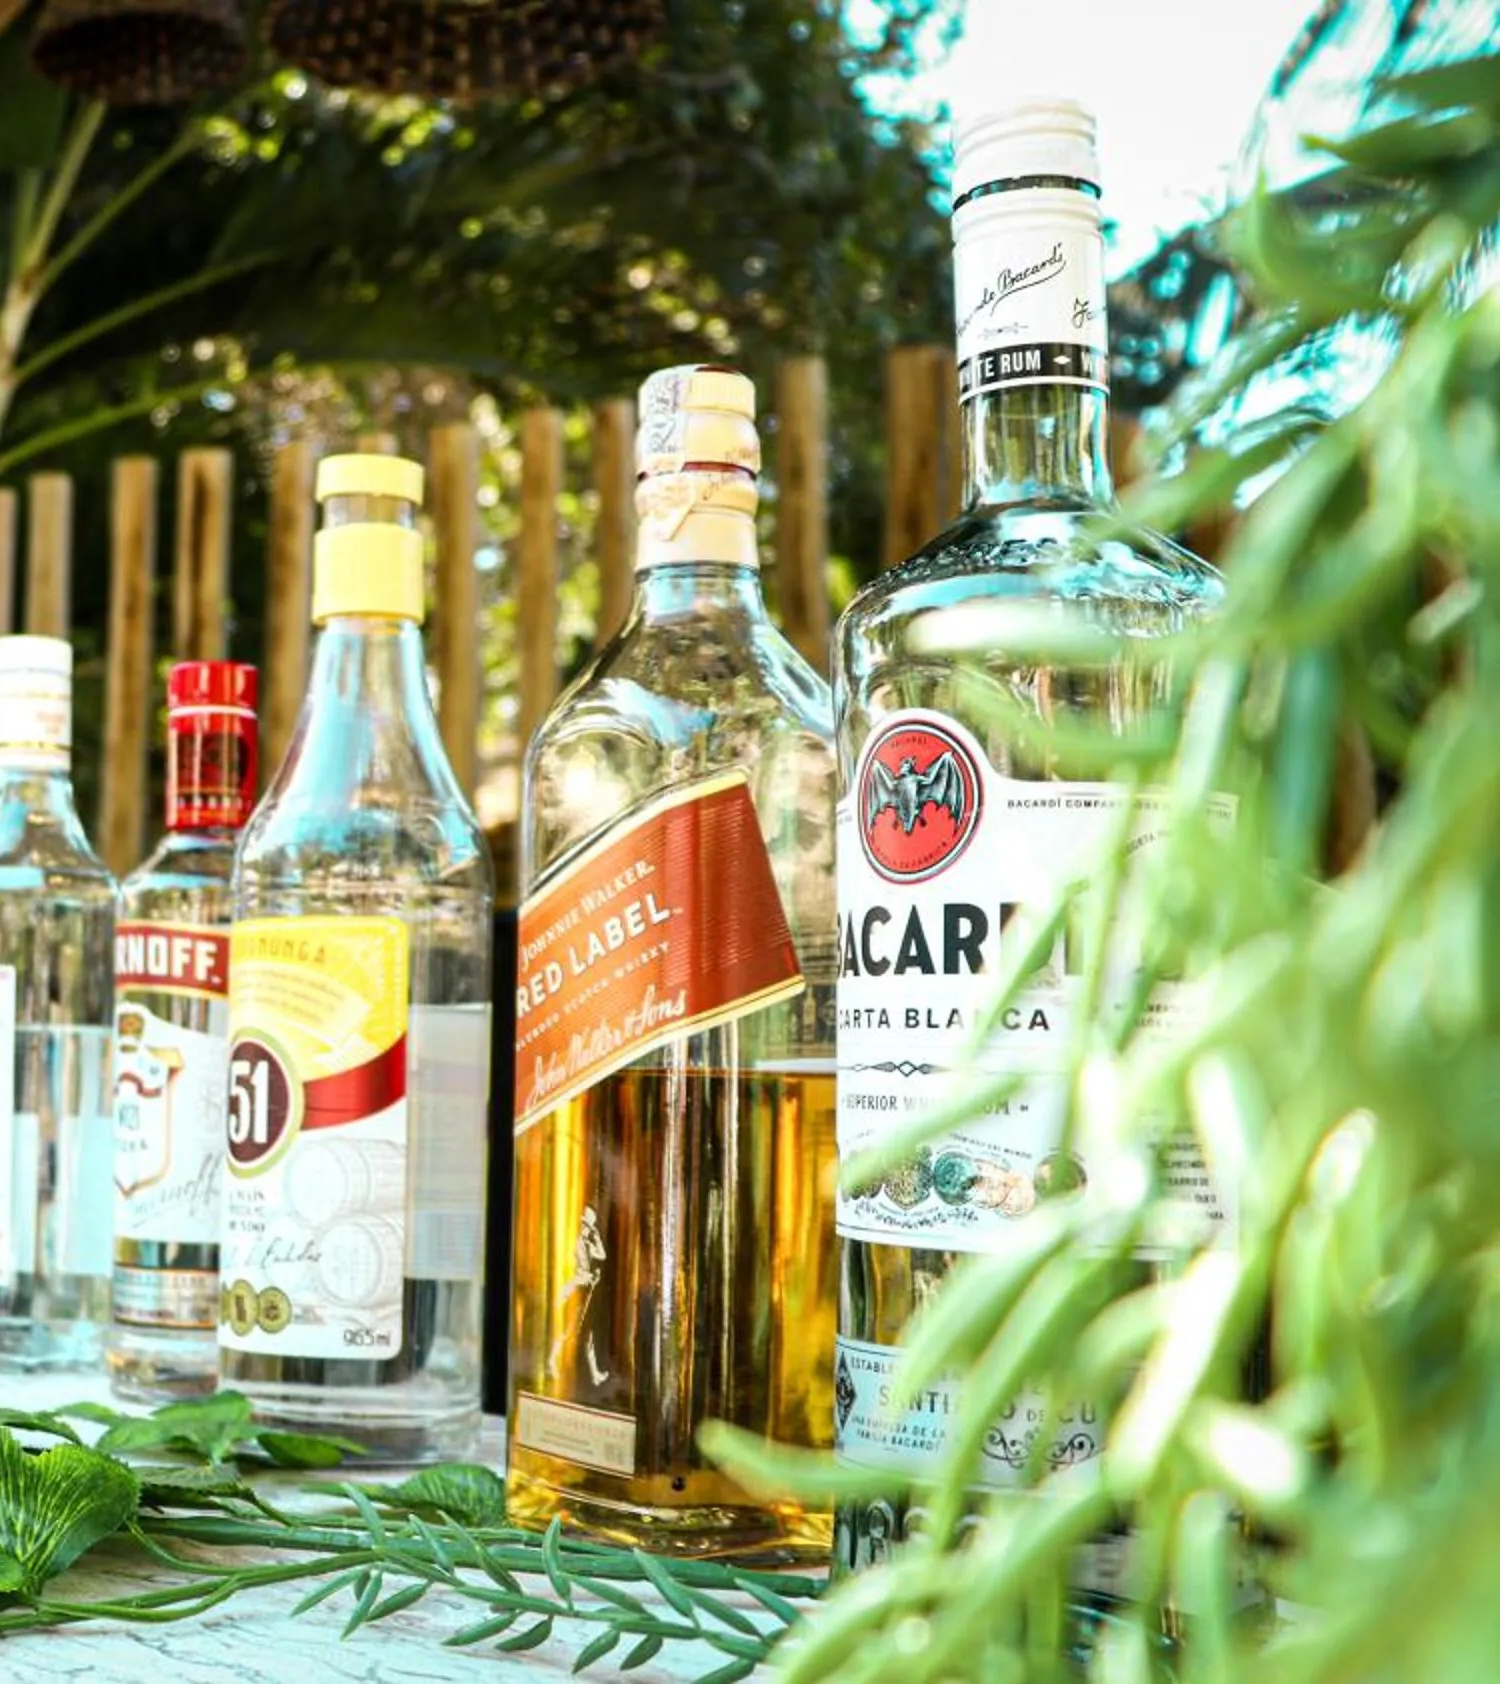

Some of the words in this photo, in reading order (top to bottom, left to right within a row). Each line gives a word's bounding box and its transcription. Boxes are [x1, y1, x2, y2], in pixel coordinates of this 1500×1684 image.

[1001, 350, 1041, 374] RUM
[516, 961, 563, 1018] RED
[905, 1008, 1050, 1031] BLACA
[230, 1060, 269, 1143] 51
